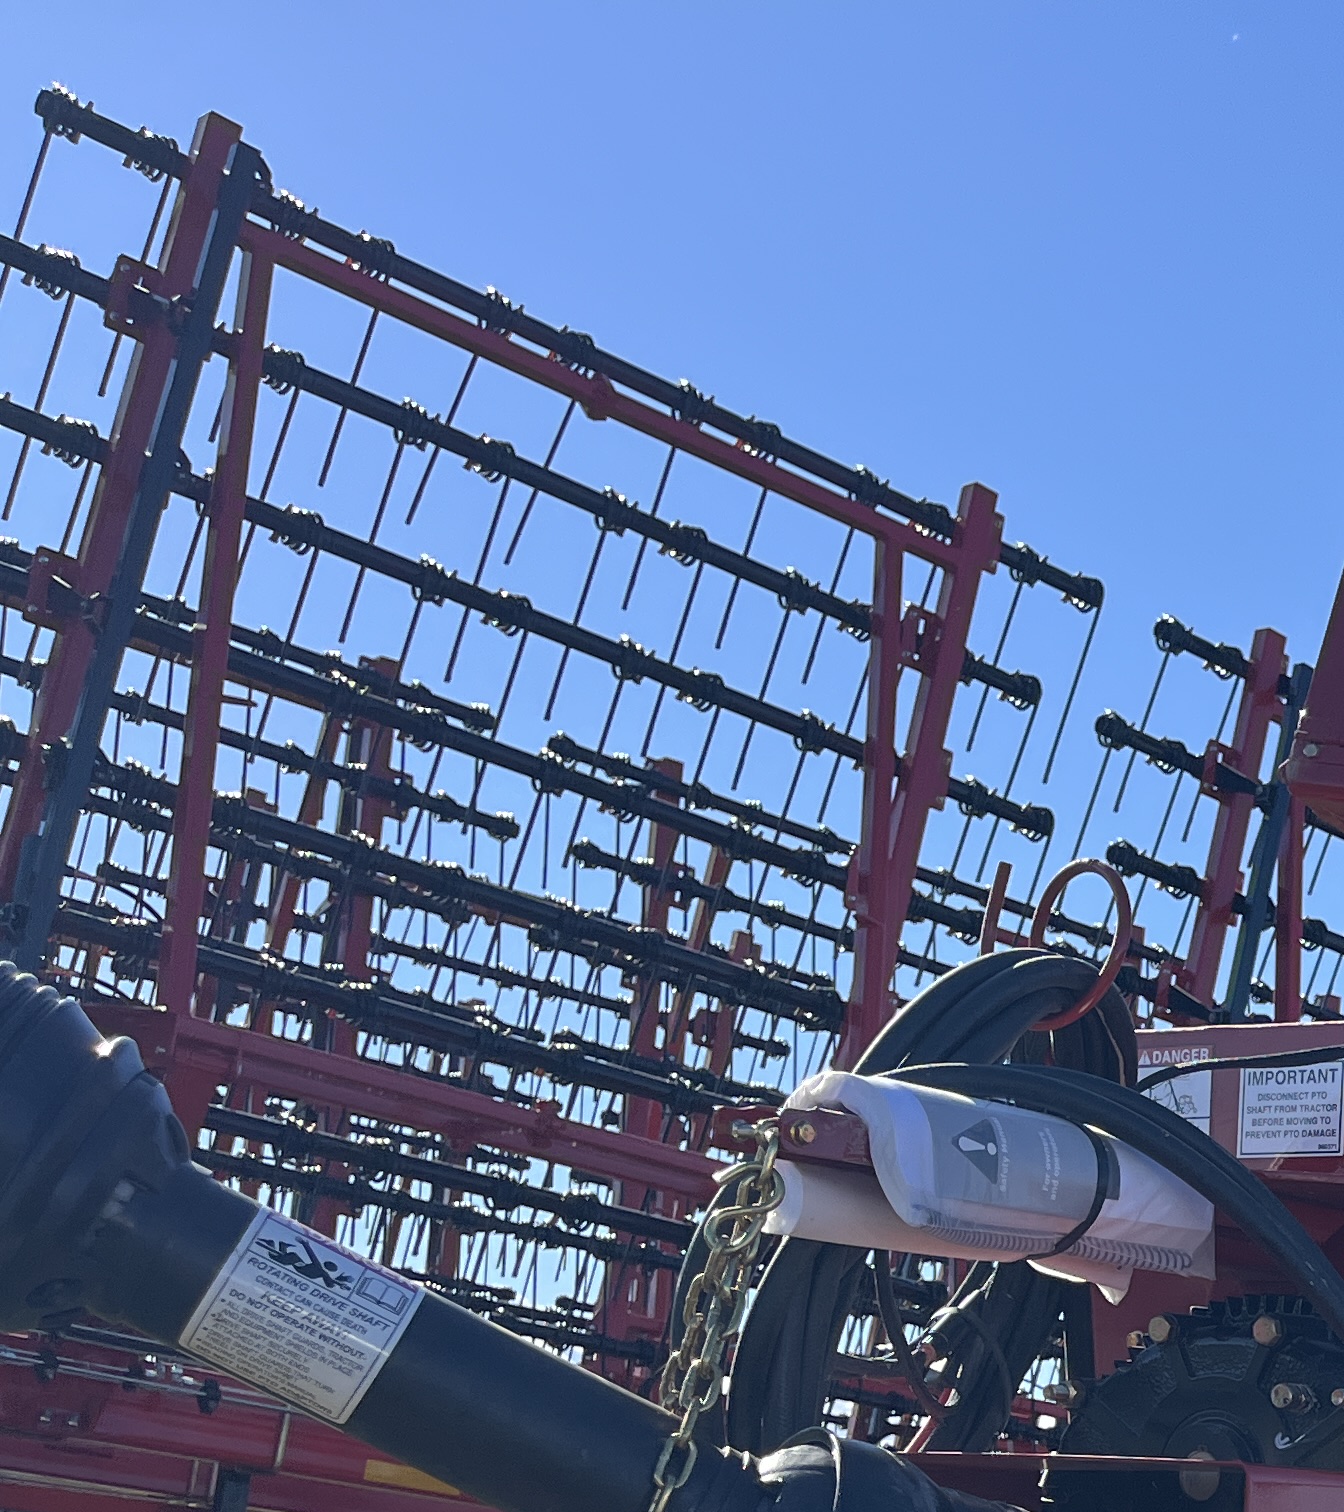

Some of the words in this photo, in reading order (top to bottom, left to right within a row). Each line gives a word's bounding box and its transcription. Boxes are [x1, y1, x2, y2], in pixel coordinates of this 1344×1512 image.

[1152, 1048, 1210, 1064] DANGER
[1248, 1069, 1338, 1086] IMPORTANT
[1258, 1092, 1309, 1101] DISCONNECT
[1311, 1091, 1328, 1100] PTO
[1247, 1105, 1272, 1114] SHAFT
[1274, 1105, 1297, 1113] FROM
[1300, 1104, 1337, 1112] TRACTOR
[1252, 1118, 1284, 1127] BEFORE
[1286, 1117, 1318, 1125] MOVING
[1320, 1116, 1331, 1125] TO
[1245, 1130, 1281, 1139] PREVENT
[1284, 1130, 1300, 1138] PTO
[1302, 1129, 1336, 1137] DAMAGE
[1042, 1173, 1051, 1192] For
[1050, 1179, 1059, 1201] and
[247, 1257, 309, 1291] ROTATING
[310, 1289, 349, 1311] DRIVE
[349, 1308, 391, 1331] SHAFT
[229, 1289, 246, 1301] DO
[247, 1297, 270, 1311] NOT
[270, 1309, 317, 1337] OPERATE
[256, 1275, 295, 1298] CONTACT
[313, 1304, 341, 1322] CAUSE
[341, 1317, 367, 1335] DEATH
